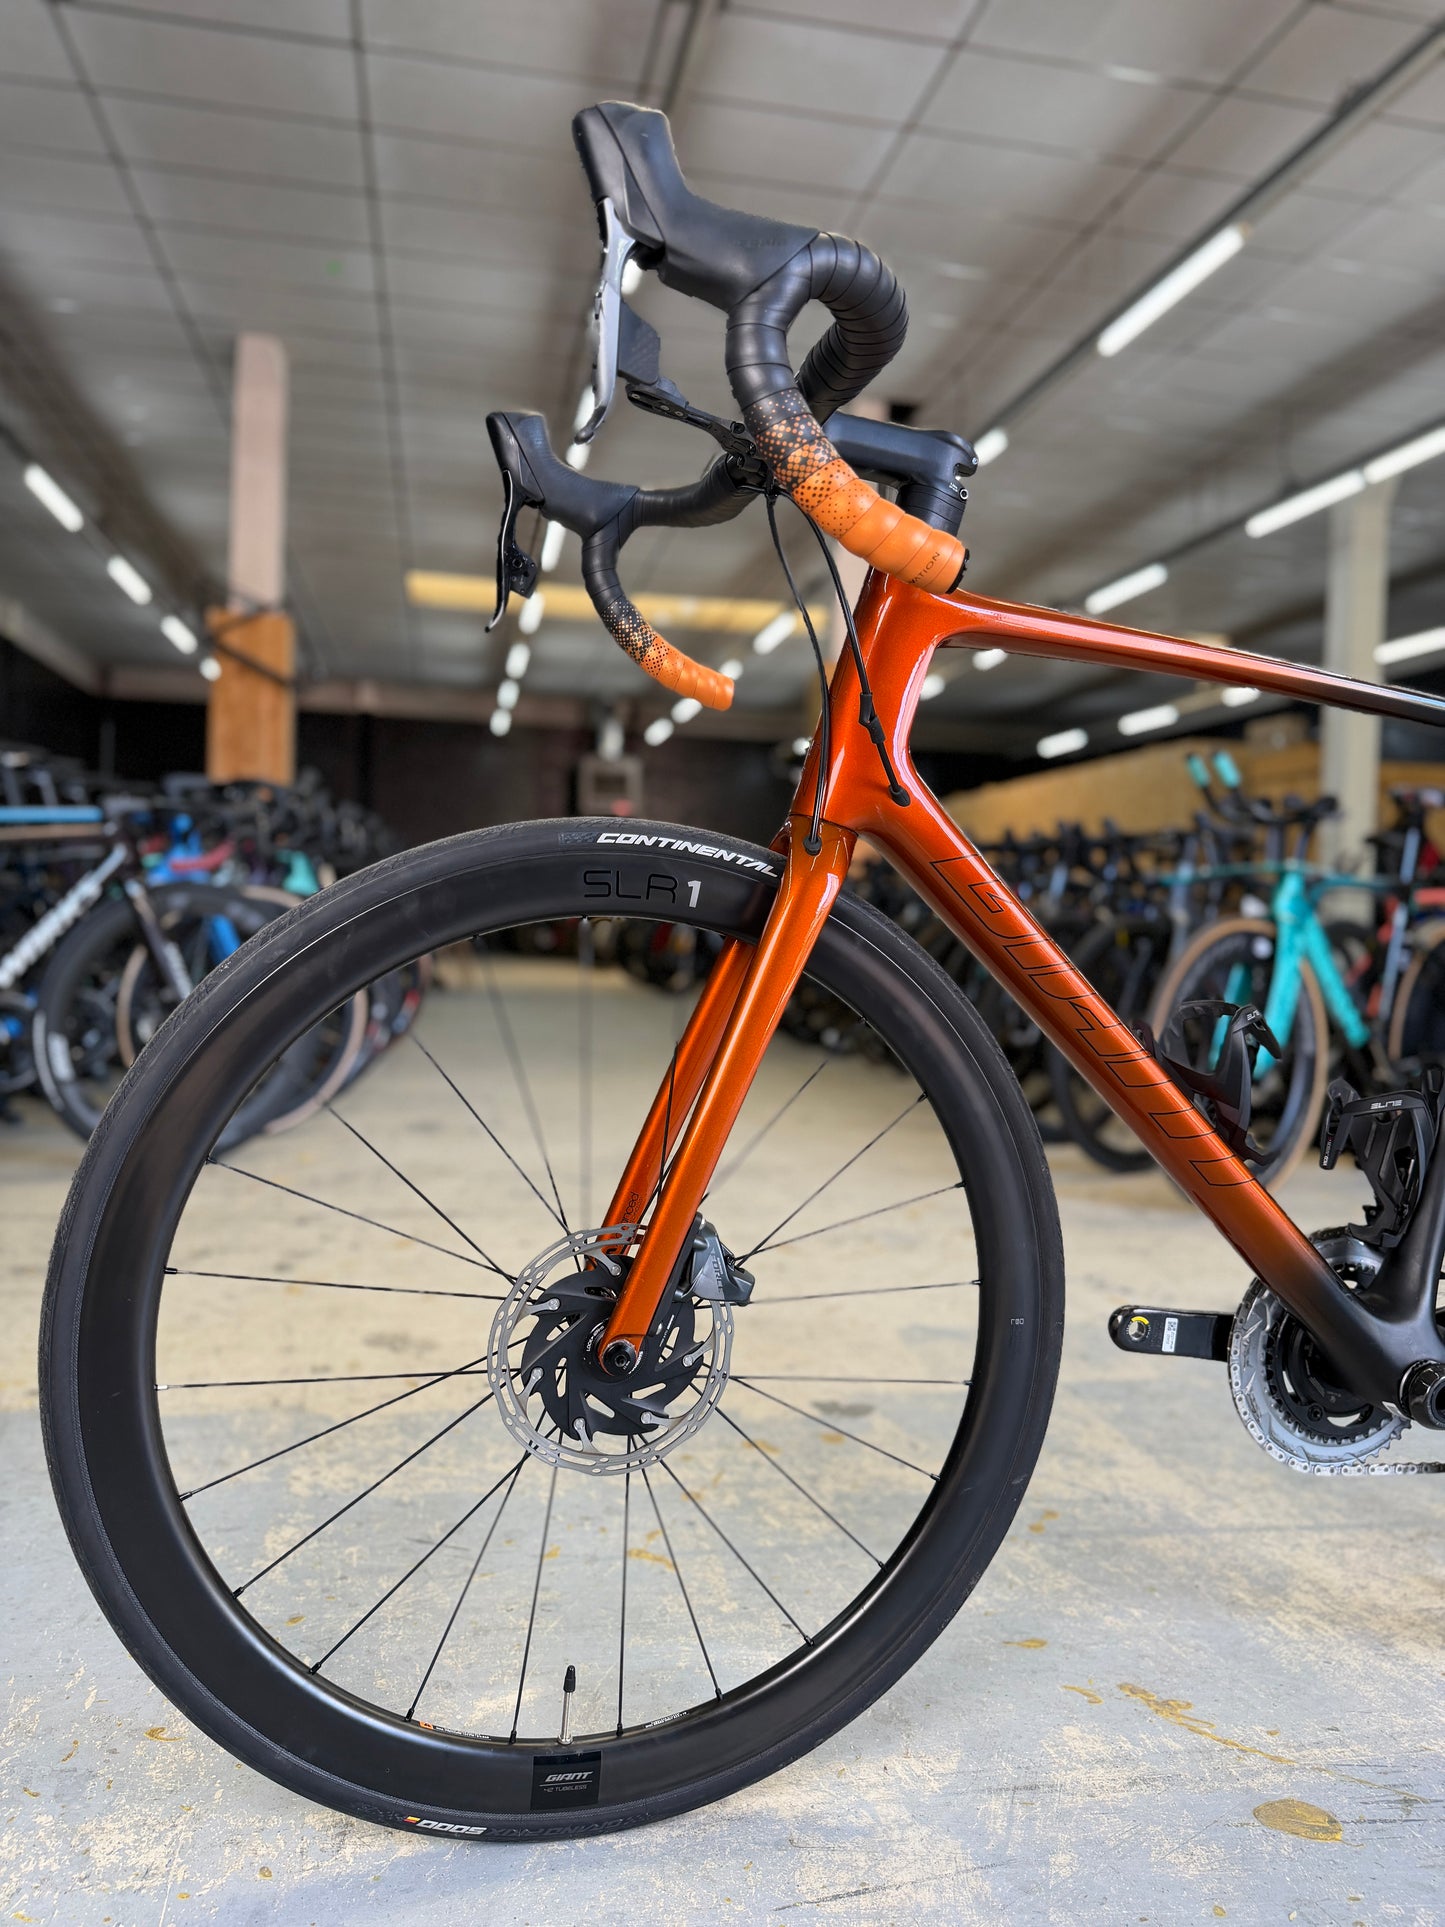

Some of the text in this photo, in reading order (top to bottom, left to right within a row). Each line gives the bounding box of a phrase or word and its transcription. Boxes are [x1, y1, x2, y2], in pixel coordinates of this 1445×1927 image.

[597, 832, 778, 877] CONTINENTAL
[583, 870, 702, 908] SLR 1
[545, 1771, 593, 1782] GIANT
[416, 1819, 487, 1835] 5000
